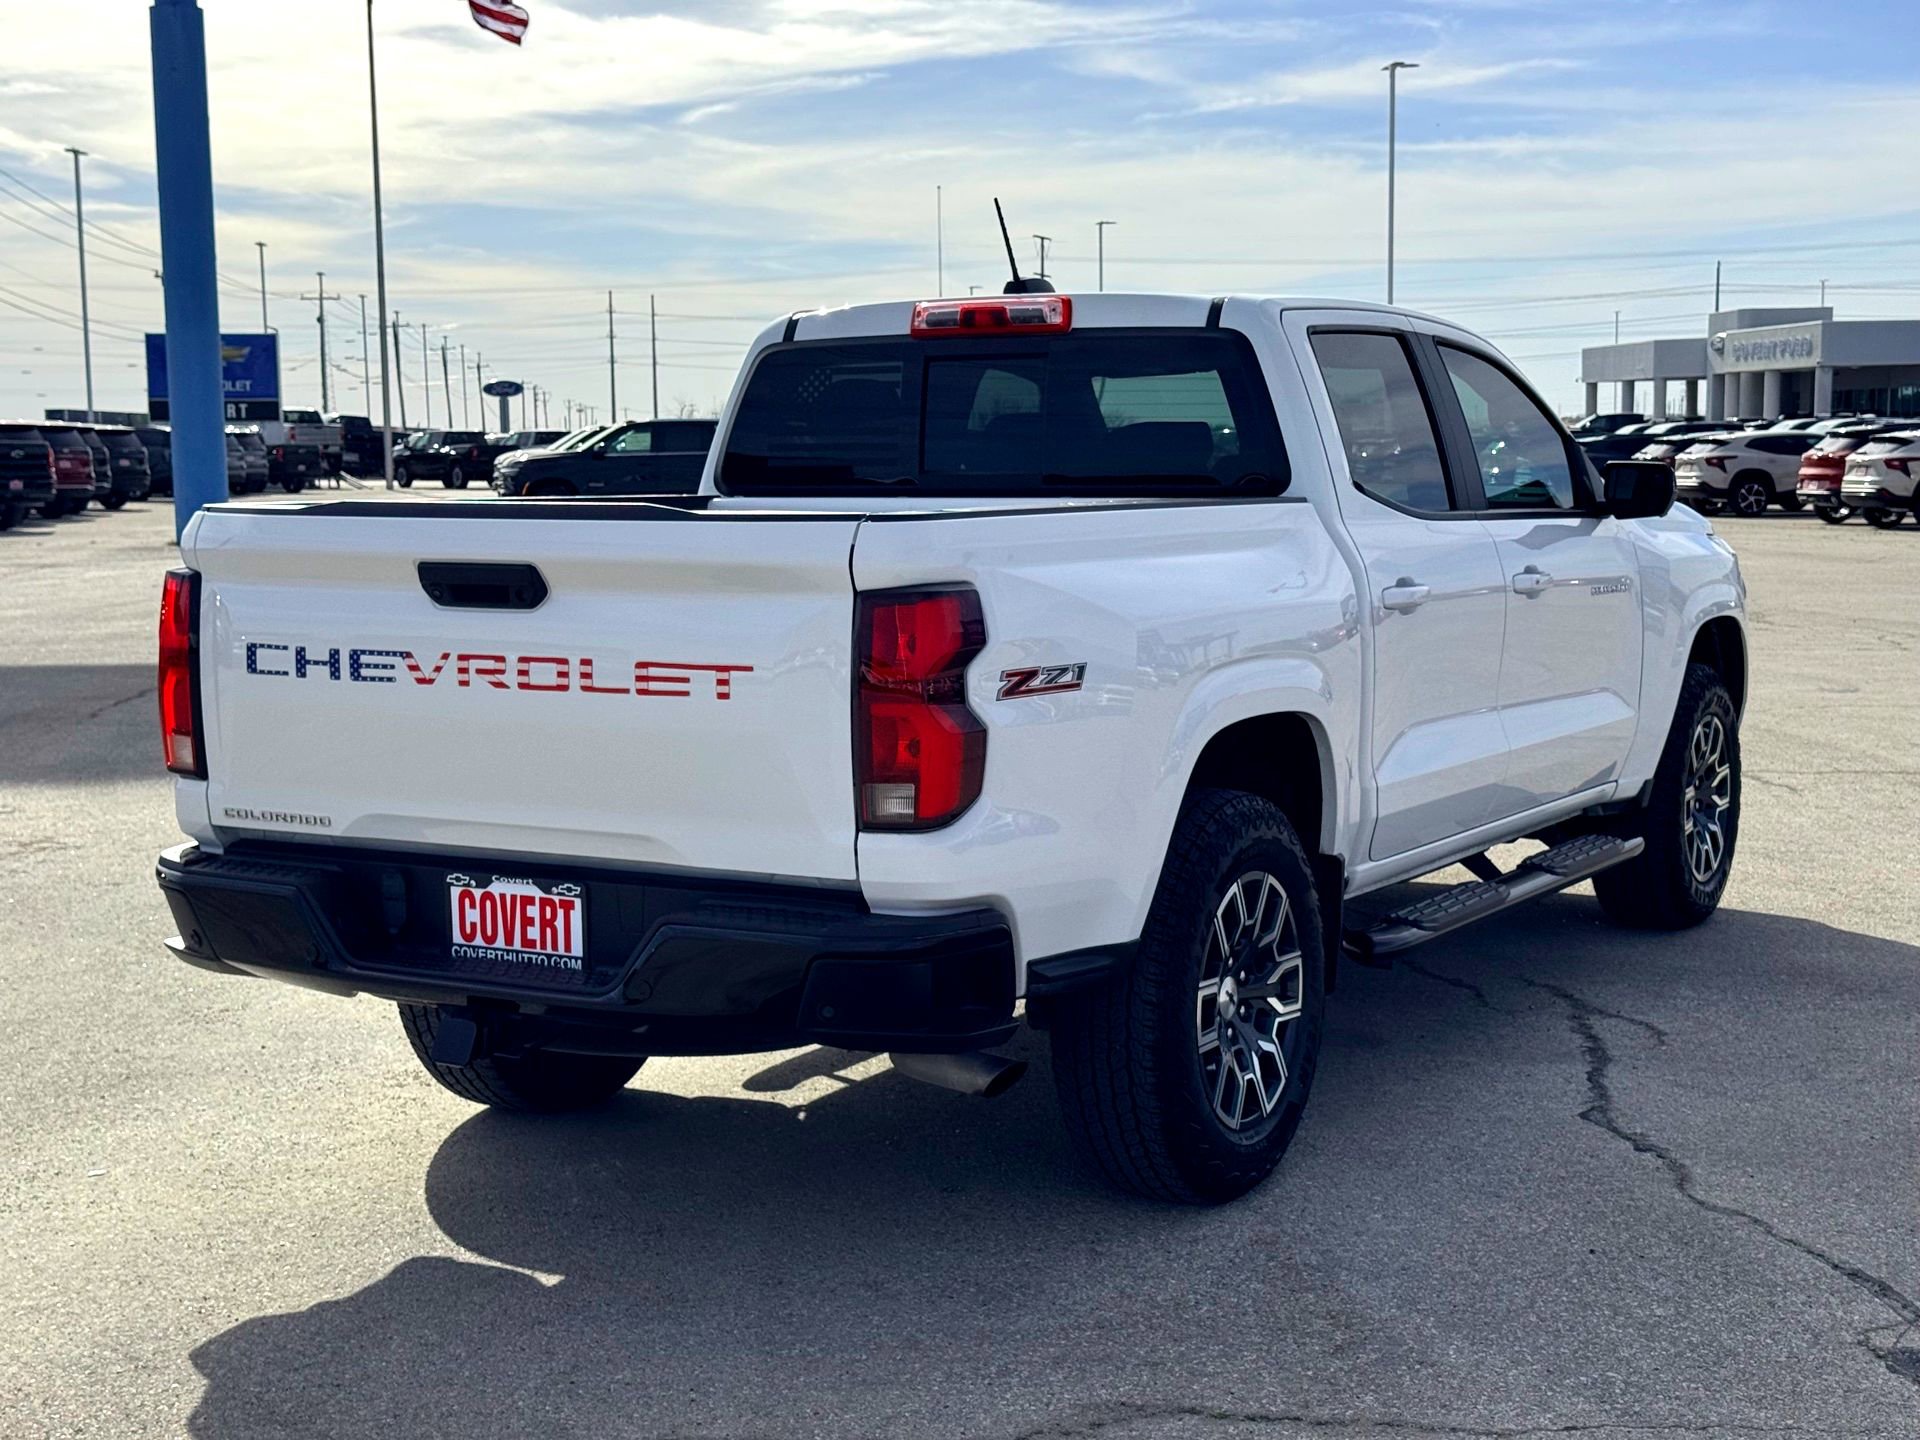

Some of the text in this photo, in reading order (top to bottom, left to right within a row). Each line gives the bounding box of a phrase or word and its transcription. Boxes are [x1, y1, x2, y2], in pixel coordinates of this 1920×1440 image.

[246, 641, 754, 700] CHEVROLET
[996, 661, 1088, 701] Z71
[223, 807, 332, 828] COLORADO
[491, 874, 534, 886] Covert
[457, 888, 576, 955] COVERT
[451, 945, 583, 971] COVERTHUTTOCOM
